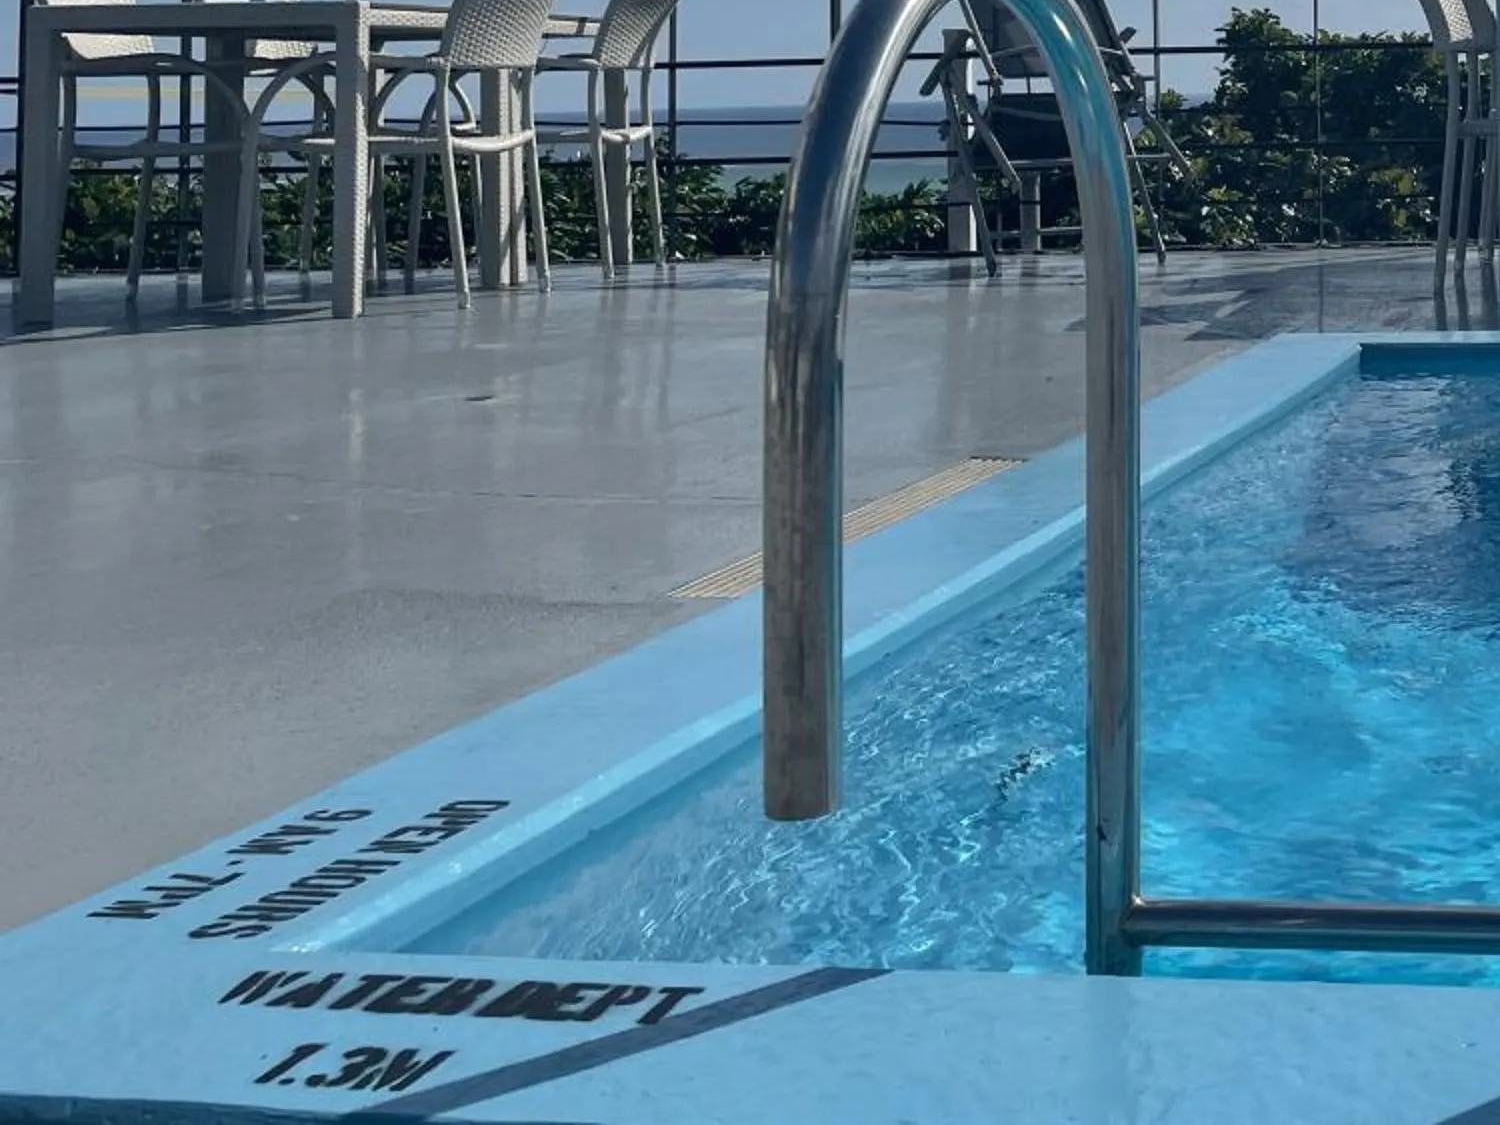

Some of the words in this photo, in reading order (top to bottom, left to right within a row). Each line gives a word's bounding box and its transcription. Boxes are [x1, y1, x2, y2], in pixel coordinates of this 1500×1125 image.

[356, 799, 511, 855] OPEN
[187, 858, 402, 940] HOURS
[217, 970, 497, 1017] WATER
[472, 979, 706, 1026] DEPT
[254, 1042, 456, 1092] 1.3M
